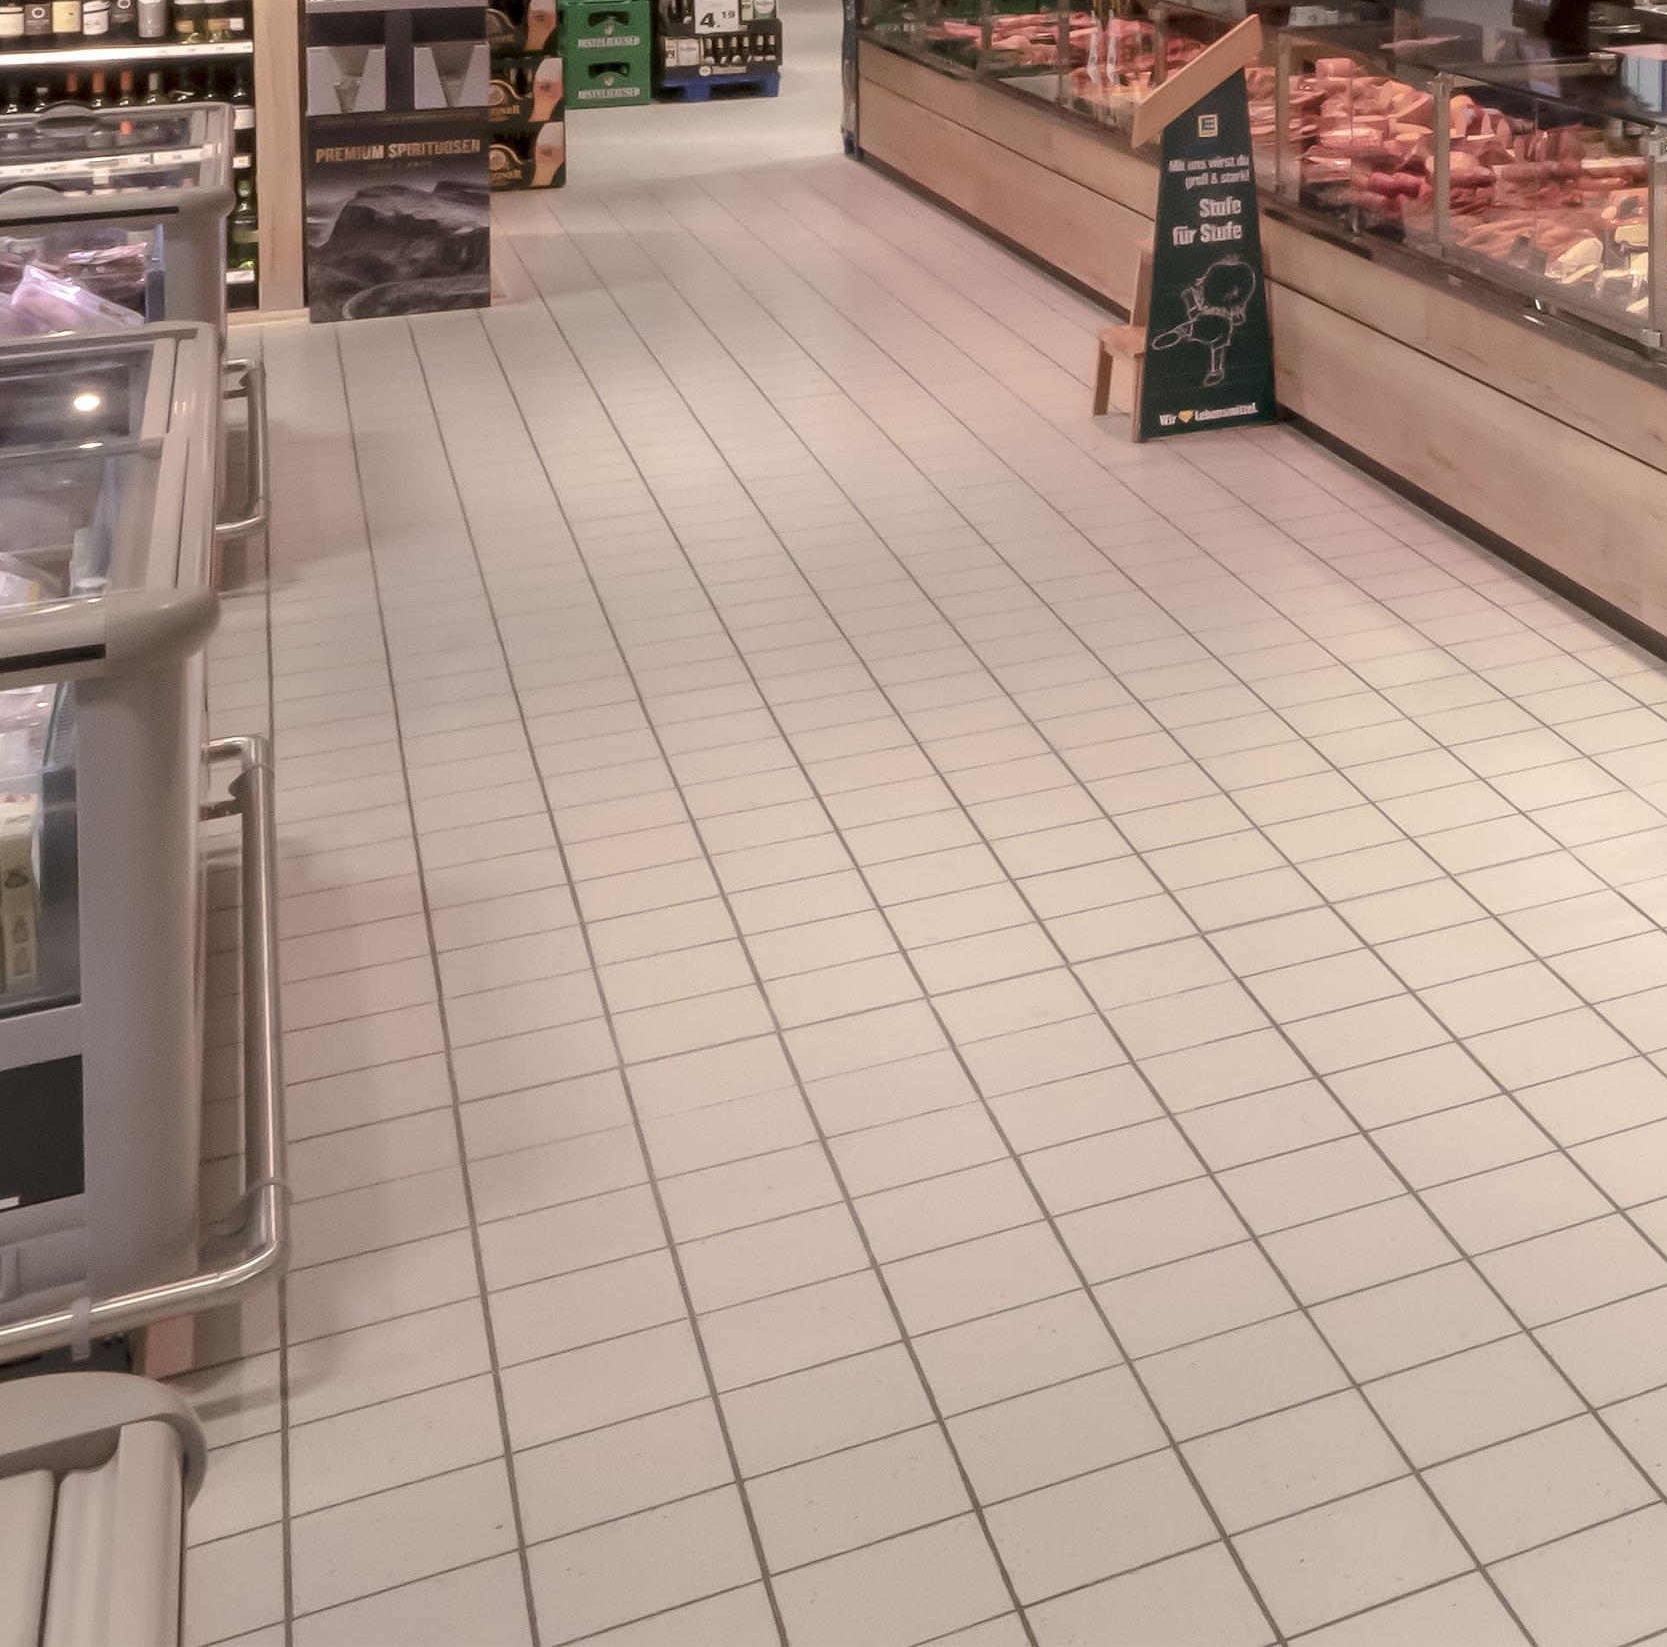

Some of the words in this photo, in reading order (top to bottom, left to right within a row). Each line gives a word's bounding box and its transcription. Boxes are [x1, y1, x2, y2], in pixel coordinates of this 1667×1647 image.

[315, 144, 385, 164] PREMIUM
[388, 138, 482, 160] SPIRITUOSEN
[1199, 195, 1242, 218] Stufe
[1172, 225, 1197, 246] für
[1200, 220, 1242, 243] Stufe
